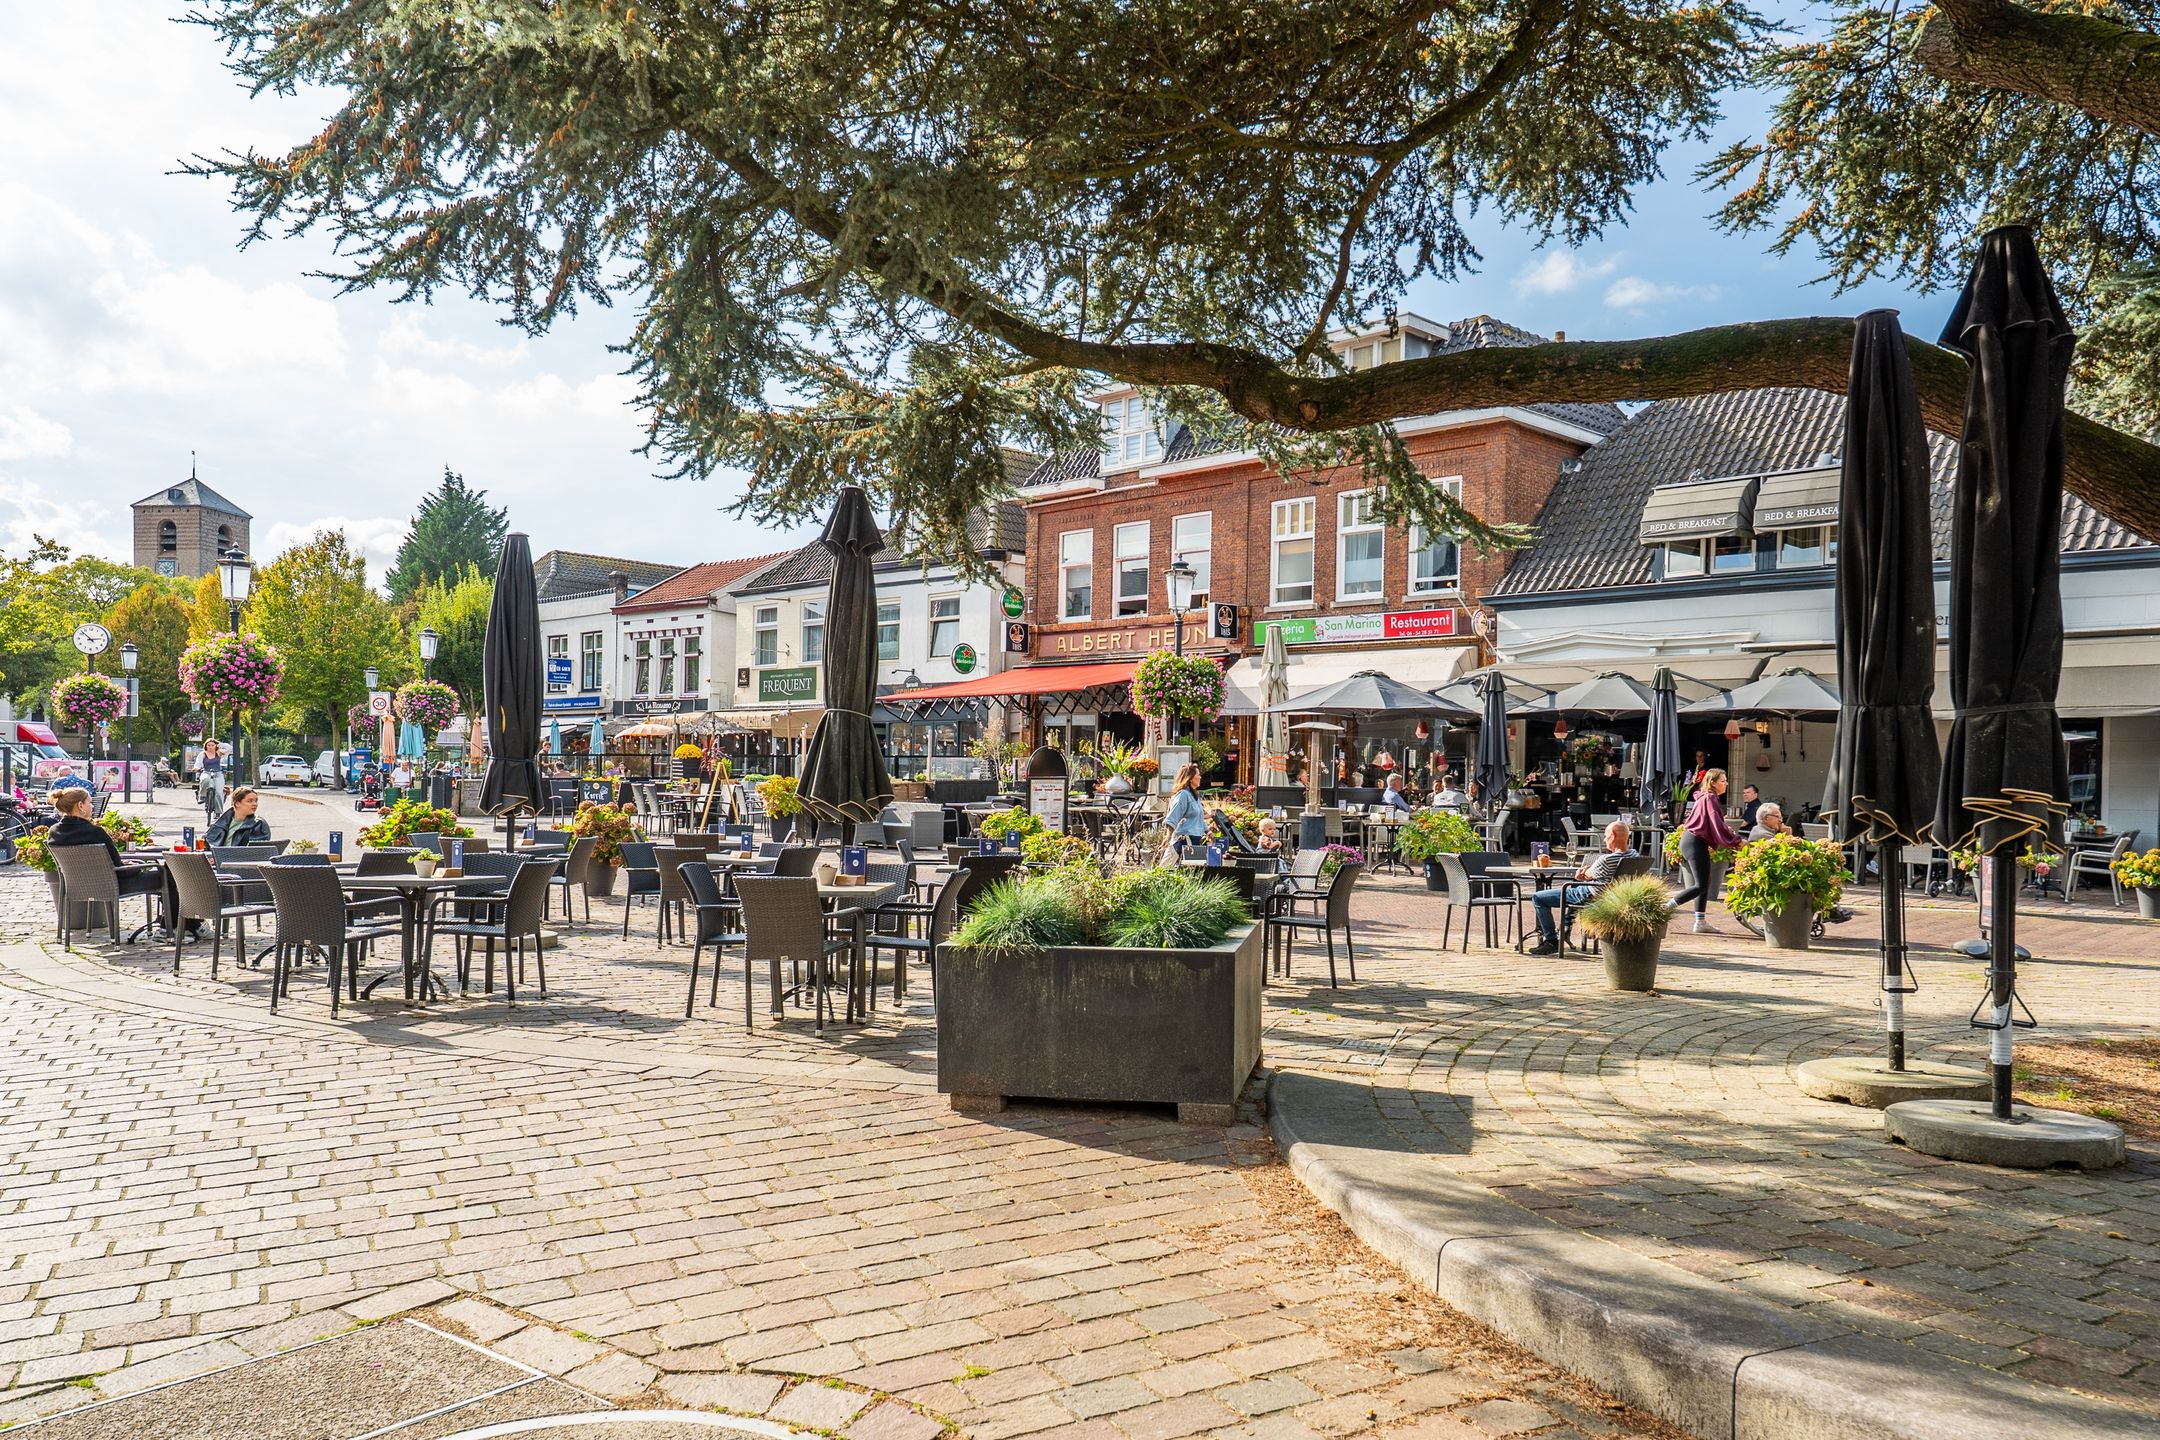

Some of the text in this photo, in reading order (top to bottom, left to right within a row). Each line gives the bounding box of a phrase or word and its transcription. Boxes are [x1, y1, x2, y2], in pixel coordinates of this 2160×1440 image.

[1764, 506, 1839, 521] BED & BREAKFA
[1649, 523, 1667, 531] BED
[1678, 517, 1727, 529] BREAKFAST
[1324, 619, 1342, 630] San
[1345, 618, 1382, 629] Marino
[1390, 613, 1450, 629] Restaurant
[1056, 631, 1136, 652] ALBERT
[763, 677, 812, 695] FREQUENT
